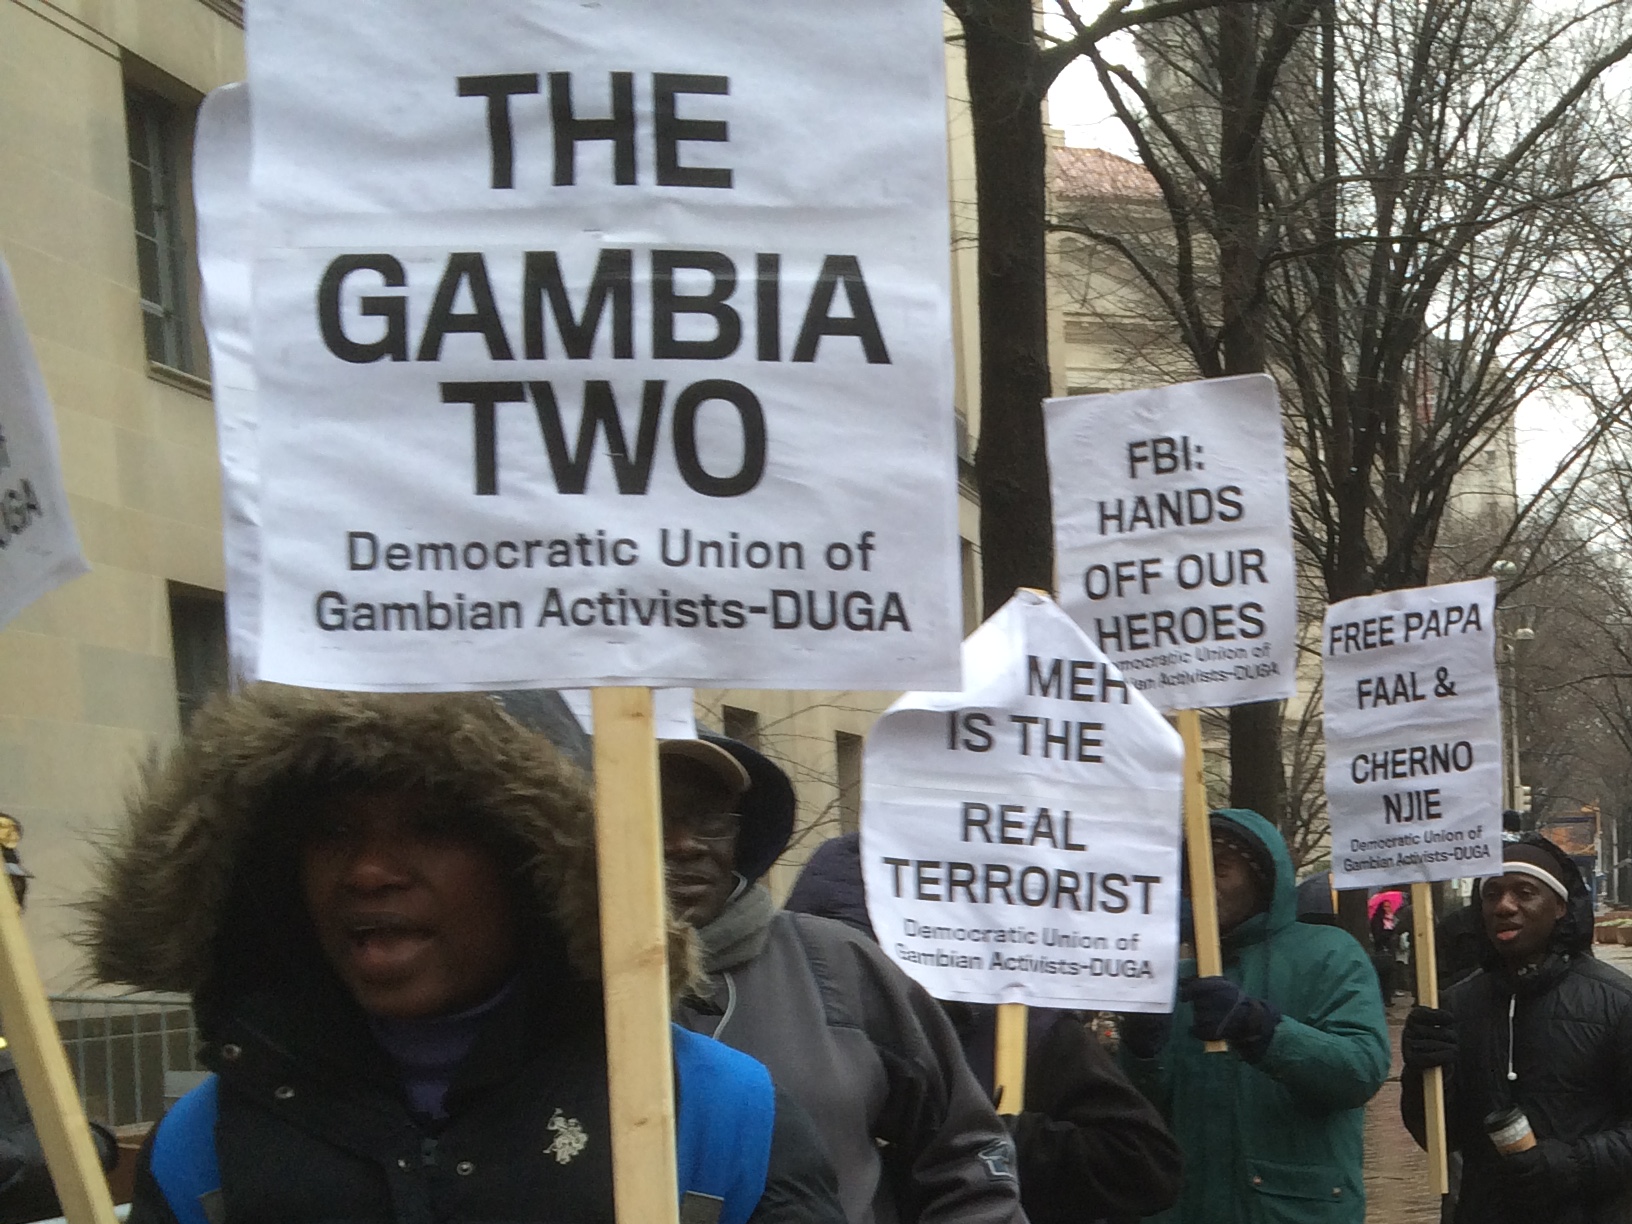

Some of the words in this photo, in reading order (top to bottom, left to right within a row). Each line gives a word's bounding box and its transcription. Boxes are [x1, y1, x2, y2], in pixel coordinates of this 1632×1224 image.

[457, 72, 735, 189] THE
[316, 249, 892, 365] GAMBIA
[440, 379, 767, 498] TWO
[1126, 435, 1205, 479] FBI:
[1097, 485, 1245, 535] HANDS
[346, 530, 640, 572] Democratic
[659, 528, 807, 570] Union
[824, 530, 875, 571] of
[1084, 558, 1161, 601] OFF
[1176, 549, 1270, 590] OUR
[314, 590, 523, 632] Gambian
[536, 586, 912, 634] Activists-DUGA
[1095, 601, 1267, 654] HEROES
[1328, 614, 1396, 656] FREE
[1403, 602, 1483, 643] PAPA
[1194, 644, 1248, 662] Union
[1356, 671, 1427, 710] FAAL
[1433, 666, 1459, 699] &
[947, 709, 996, 752] IS
[1009, 714, 1105, 764] THE
[1351, 740, 1474, 785] CHERNO
[960, 801, 1088, 852] REAL
[1382, 788, 1444, 825] NJIE
[1343, 854, 1394, 872] Gambian
[1395, 843, 1492, 868] Activists-DUGA
[1350, 832, 1421, 853] Democratic
[1423, 829, 1464, 844] Union
[1467, 825, 1483, 840] of
[880, 855, 1162, 916] TERRORIST
[903, 917, 1039, 945] Democratic
[1041, 926, 1109, 951] Union
[1115, 932, 1141, 952] of
[894, 941, 984, 971] Gambian
[988, 950, 1155, 980] Activists-DUGA
